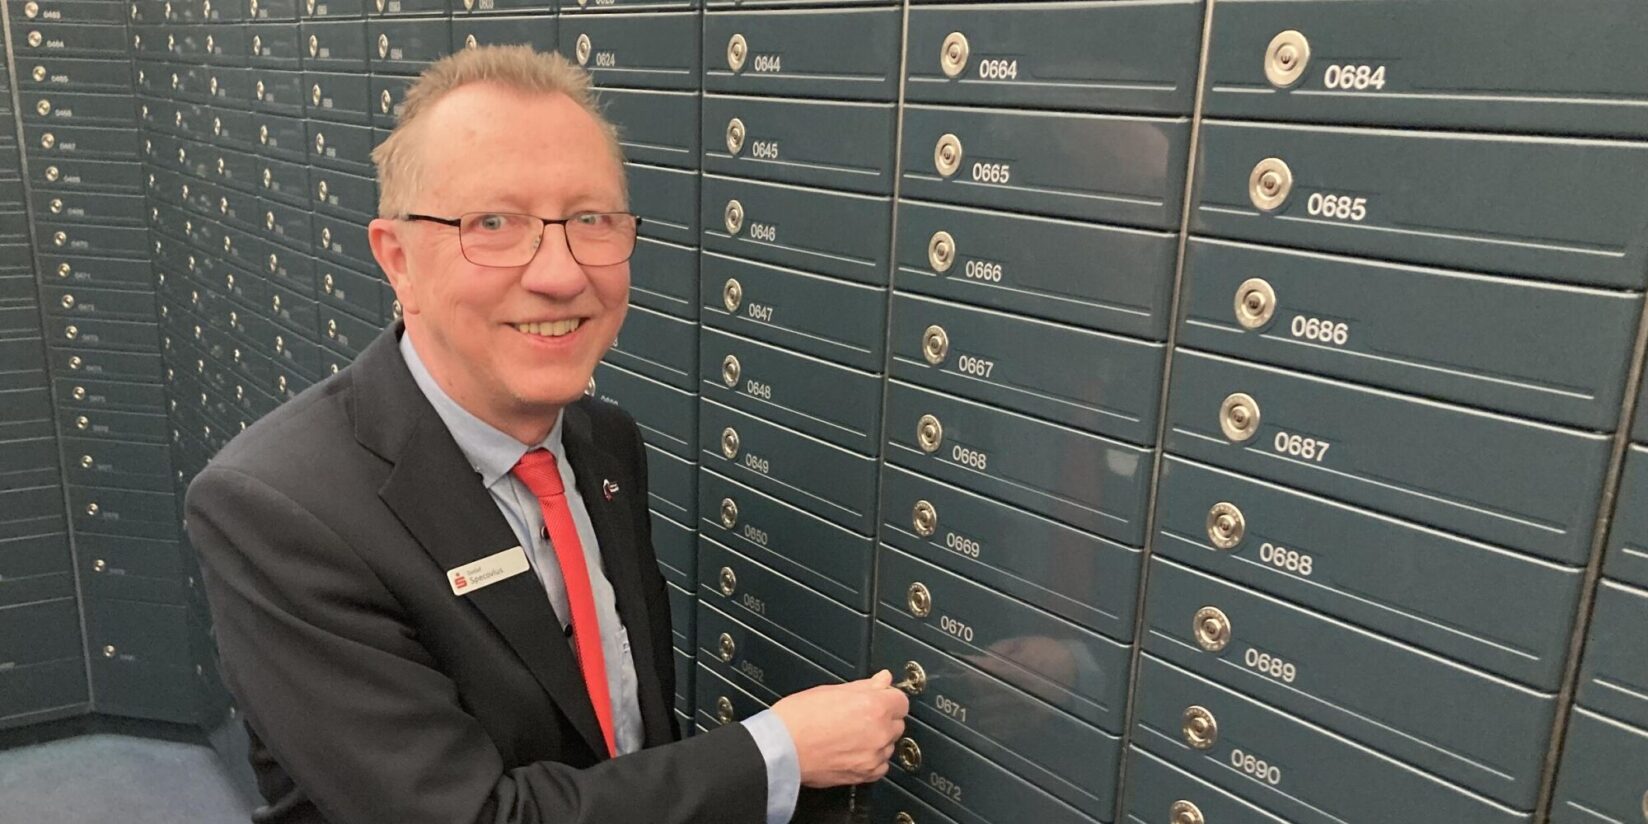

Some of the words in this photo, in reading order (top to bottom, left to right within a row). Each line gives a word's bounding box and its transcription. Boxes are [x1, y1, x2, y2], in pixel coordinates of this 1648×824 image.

[596, 53, 615, 67] 0624
[754, 56, 781, 72] 0644
[979, 60, 1017, 80] 0664
[1324, 65, 1386, 90] 0684
[752, 142, 778, 159] 0645
[972, 162, 1009, 183] 0665
[1307, 193, 1367, 221] 0685
[750, 224, 775, 241] 0646
[965, 261, 1002, 282] 0666
[748, 303, 773, 321] 0647
[1291, 315, 1349, 345] 0686
[958, 355, 994, 378] 0667
[747, 380, 771, 400] 0648
[952, 445, 987, 470] 0668
[1274, 431, 1330, 462] 0687
[745, 453, 769, 474] 0649
[744, 524, 768, 546] 0650
[946, 533, 980, 558] 0669
[1259, 542, 1313, 576] 0688
[743, 593, 766, 615] 0651
[940, 615, 973, 642] 0670
[741, 660, 764, 683] 0652
[1245, 647, 1296, 683] 0689
[935, 695, 967, 723] 0671
[1231, 748, 1281, 785] 0690
[930, 772, 962, 801] 0672
